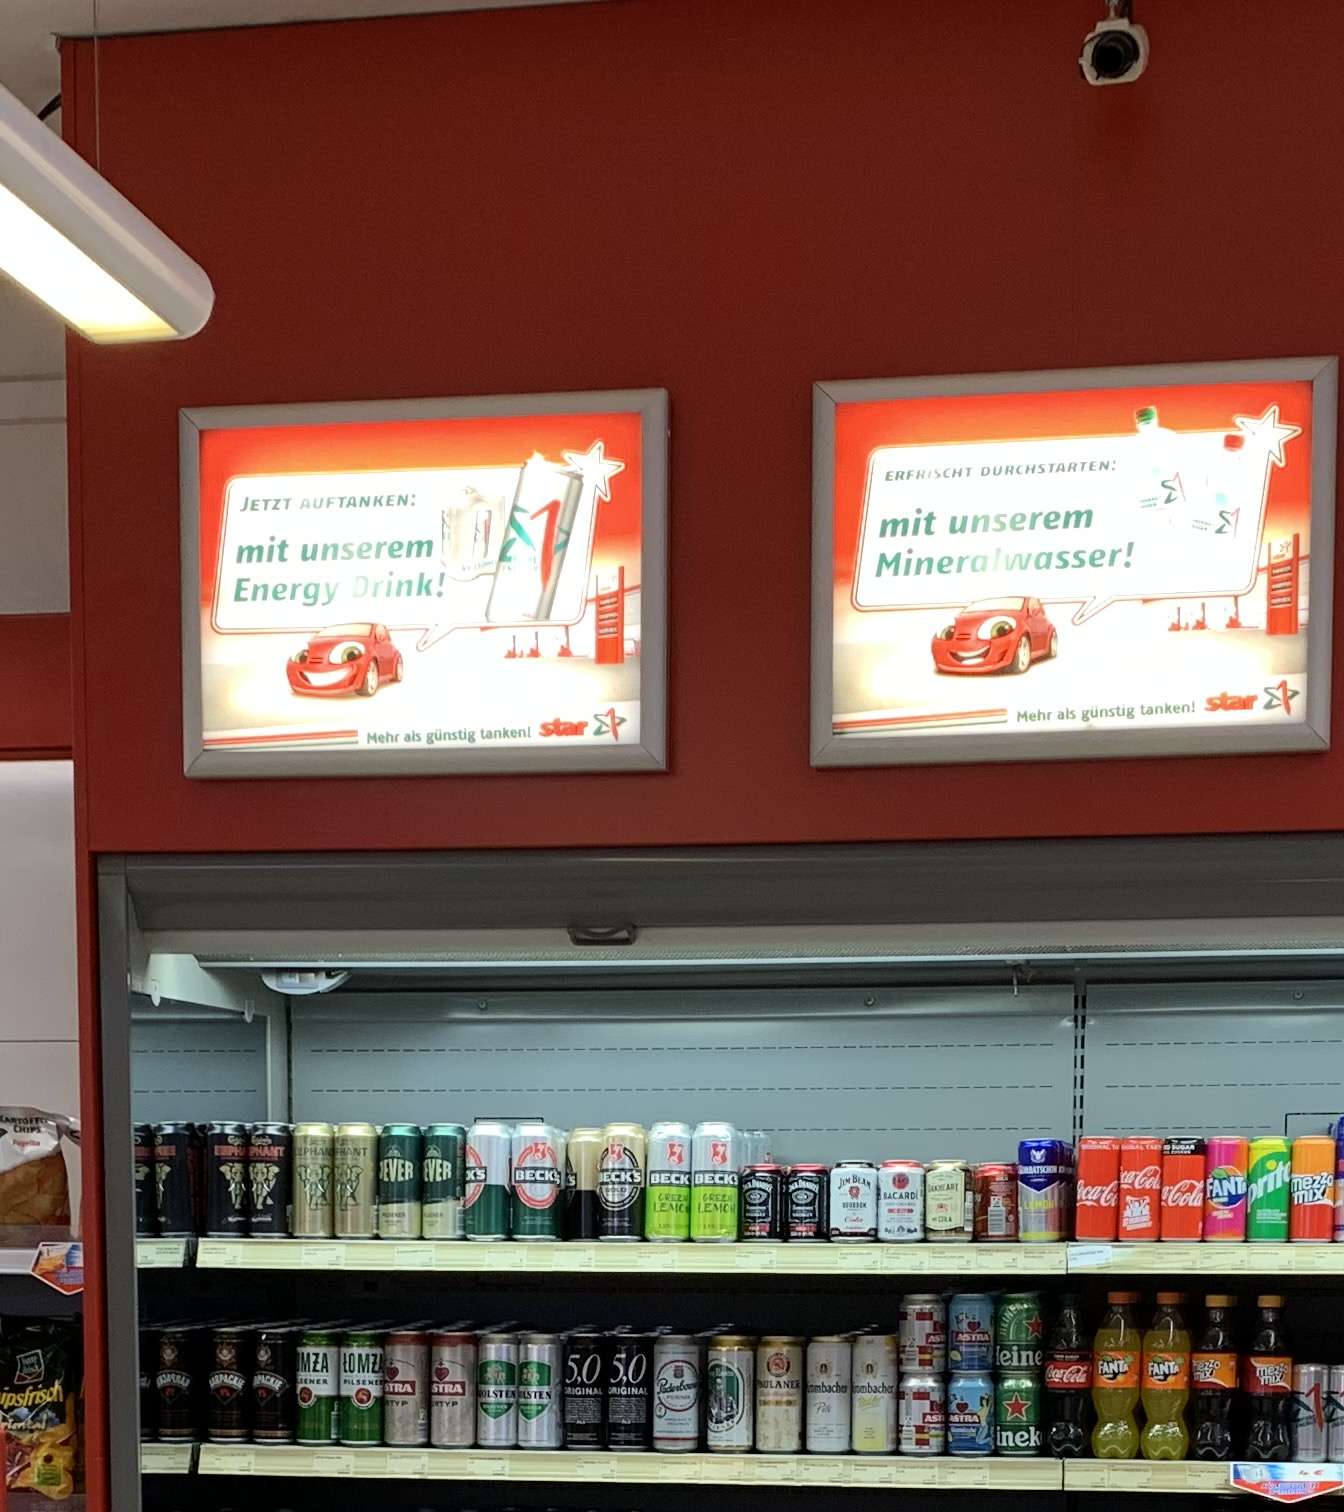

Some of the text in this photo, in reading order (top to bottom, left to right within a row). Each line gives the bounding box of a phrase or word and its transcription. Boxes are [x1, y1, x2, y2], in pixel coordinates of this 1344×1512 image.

[980, 460, 1117, 476] DURCHSTARTEN:
[241, 497, 292, 512] JETZT
[879, 508, 1093, 537] mit unserem
[236, 536, 433, 563] mit unserem
[875, 542, 1135, 577] Mineralwasser!
[233, 573, 446, 606] Energy Drink!
[1205, 691, 1258, 712] star
[1016, 701, 1195, 722] Mehr als günstig tanken!
[366, 726, 532, 745] Mehr als günstig tanken!
[539, 719, 588, 737] star
[13, 1124, 42, 1133] CHIPS
[852, 1174, 871, 1189] BEAM
[1291, 1173, 1333, 1190] mezzo
[1293, 1188, 1325, 1204] mix
[956, 1333, 989, 1342] ASTRA
[565, 1353, 601, 1385] 5,0
[609, 1353, 647, 1386] 5,0
[1045, 1363, 1087, 1385] Coca-Cola
[1098, 1358, 1129, 1377] FANTA
[1148, 1359, 1179, 1378] FANTA
[1257, 1363, 1288, 1379] mezzo
[1260, 1372, 1280, 1385] mix
